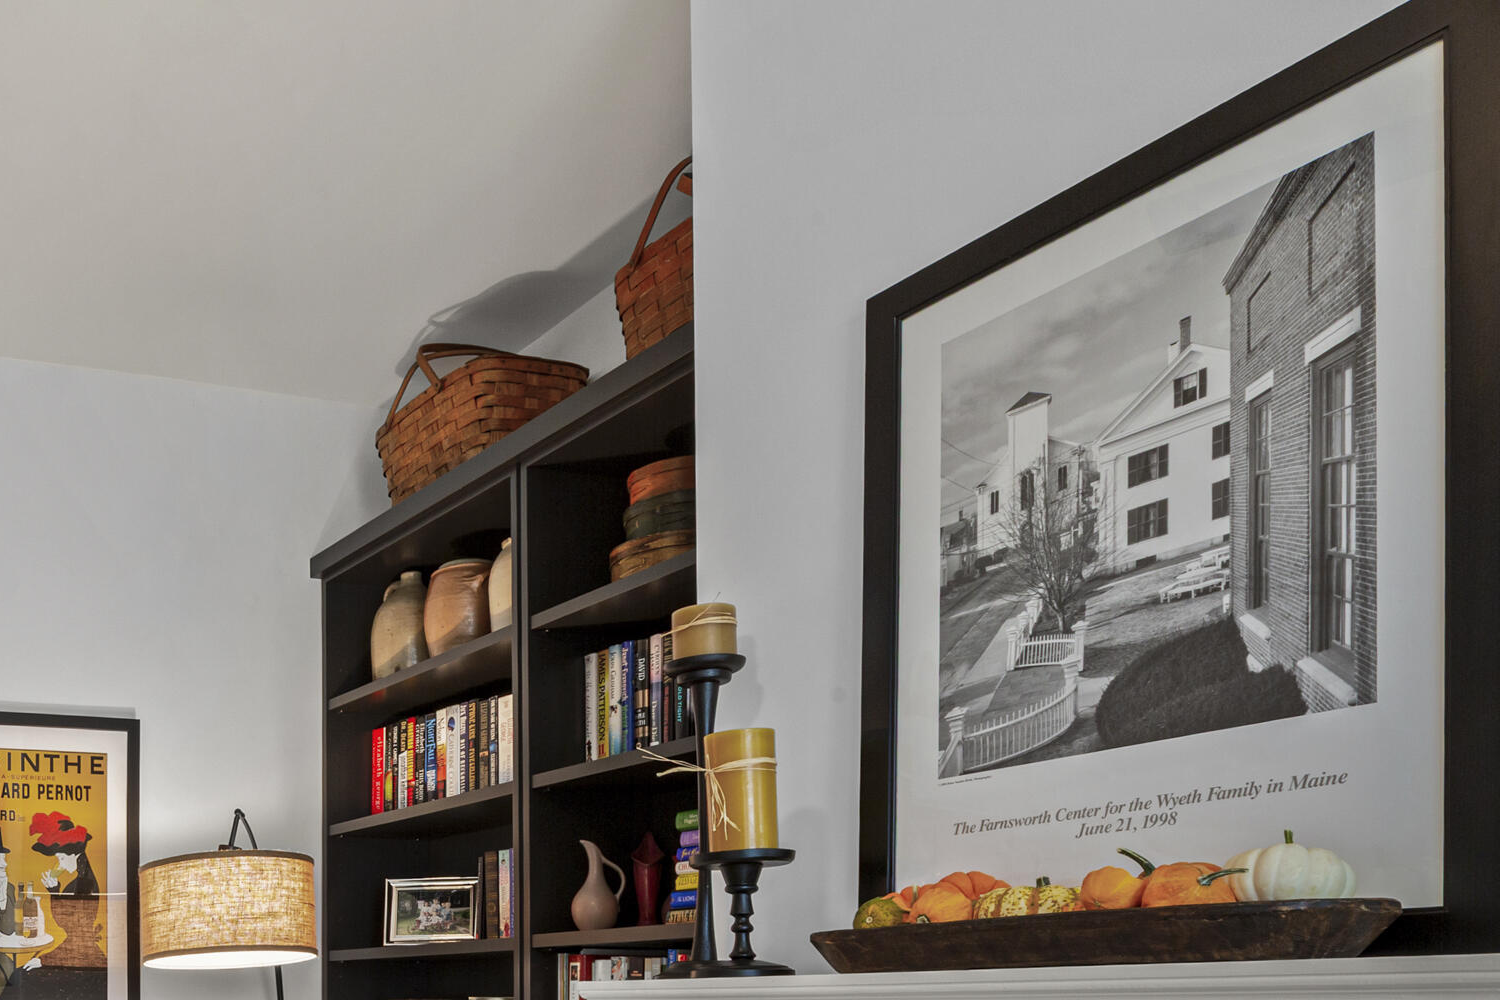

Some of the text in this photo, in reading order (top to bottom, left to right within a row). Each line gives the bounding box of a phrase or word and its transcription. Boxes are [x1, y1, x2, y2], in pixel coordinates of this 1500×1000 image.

[598, 654, 606, 741] JAMES PATTERSON
[37, 784, 91, 802] PERNOT
[953, 772, 1348, 836] The Farnsworth Center for the Wyeth Family in Maine
[1075, 812, 1178, 839] June 21, 1998
